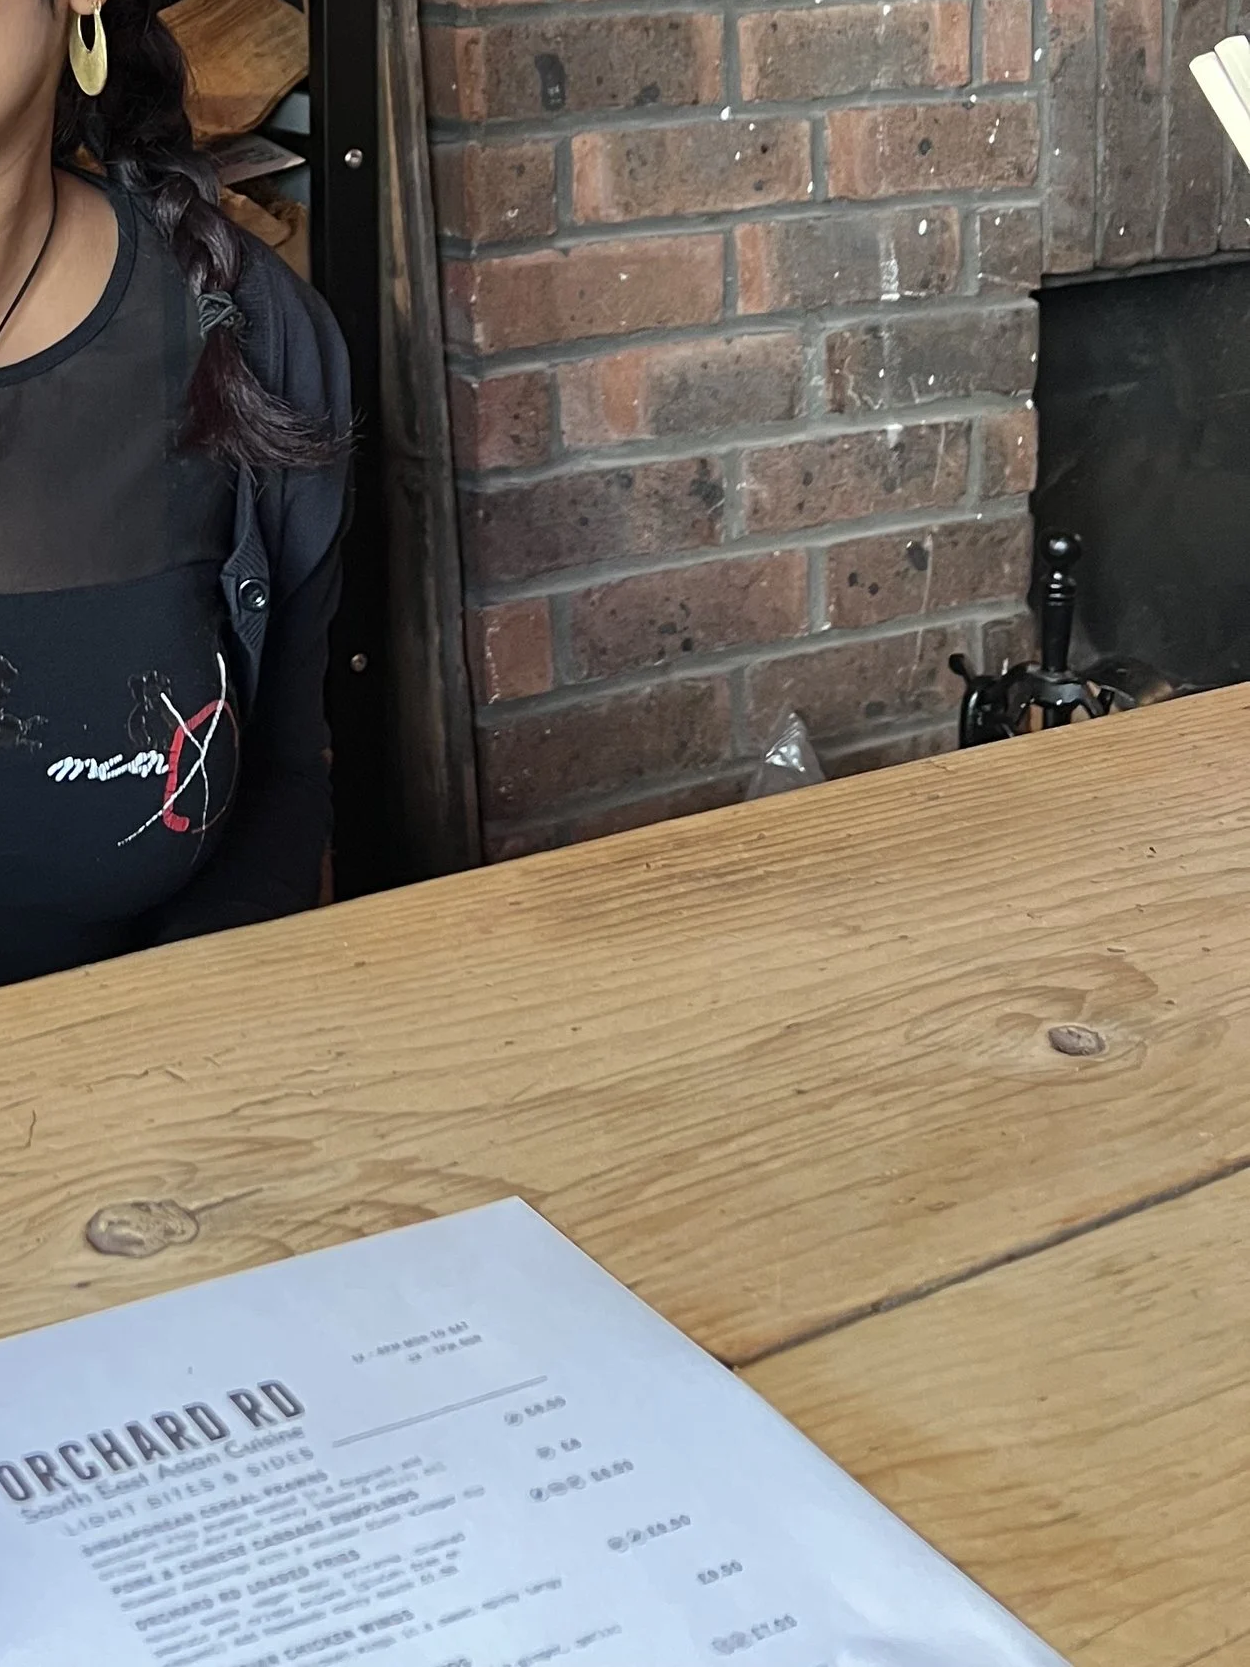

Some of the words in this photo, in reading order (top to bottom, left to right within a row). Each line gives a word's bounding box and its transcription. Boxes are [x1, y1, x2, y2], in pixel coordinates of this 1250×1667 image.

[226, 1378, 307, 1430] RD
[19, 1486, 93, 1525] South
[95, 1472, 151, 1501] East
[157, 1452, 222, 1481] Asian
[223, 1425, 307, 1459] Cuisine
[245, 1445, 316, 1479] SIDES
